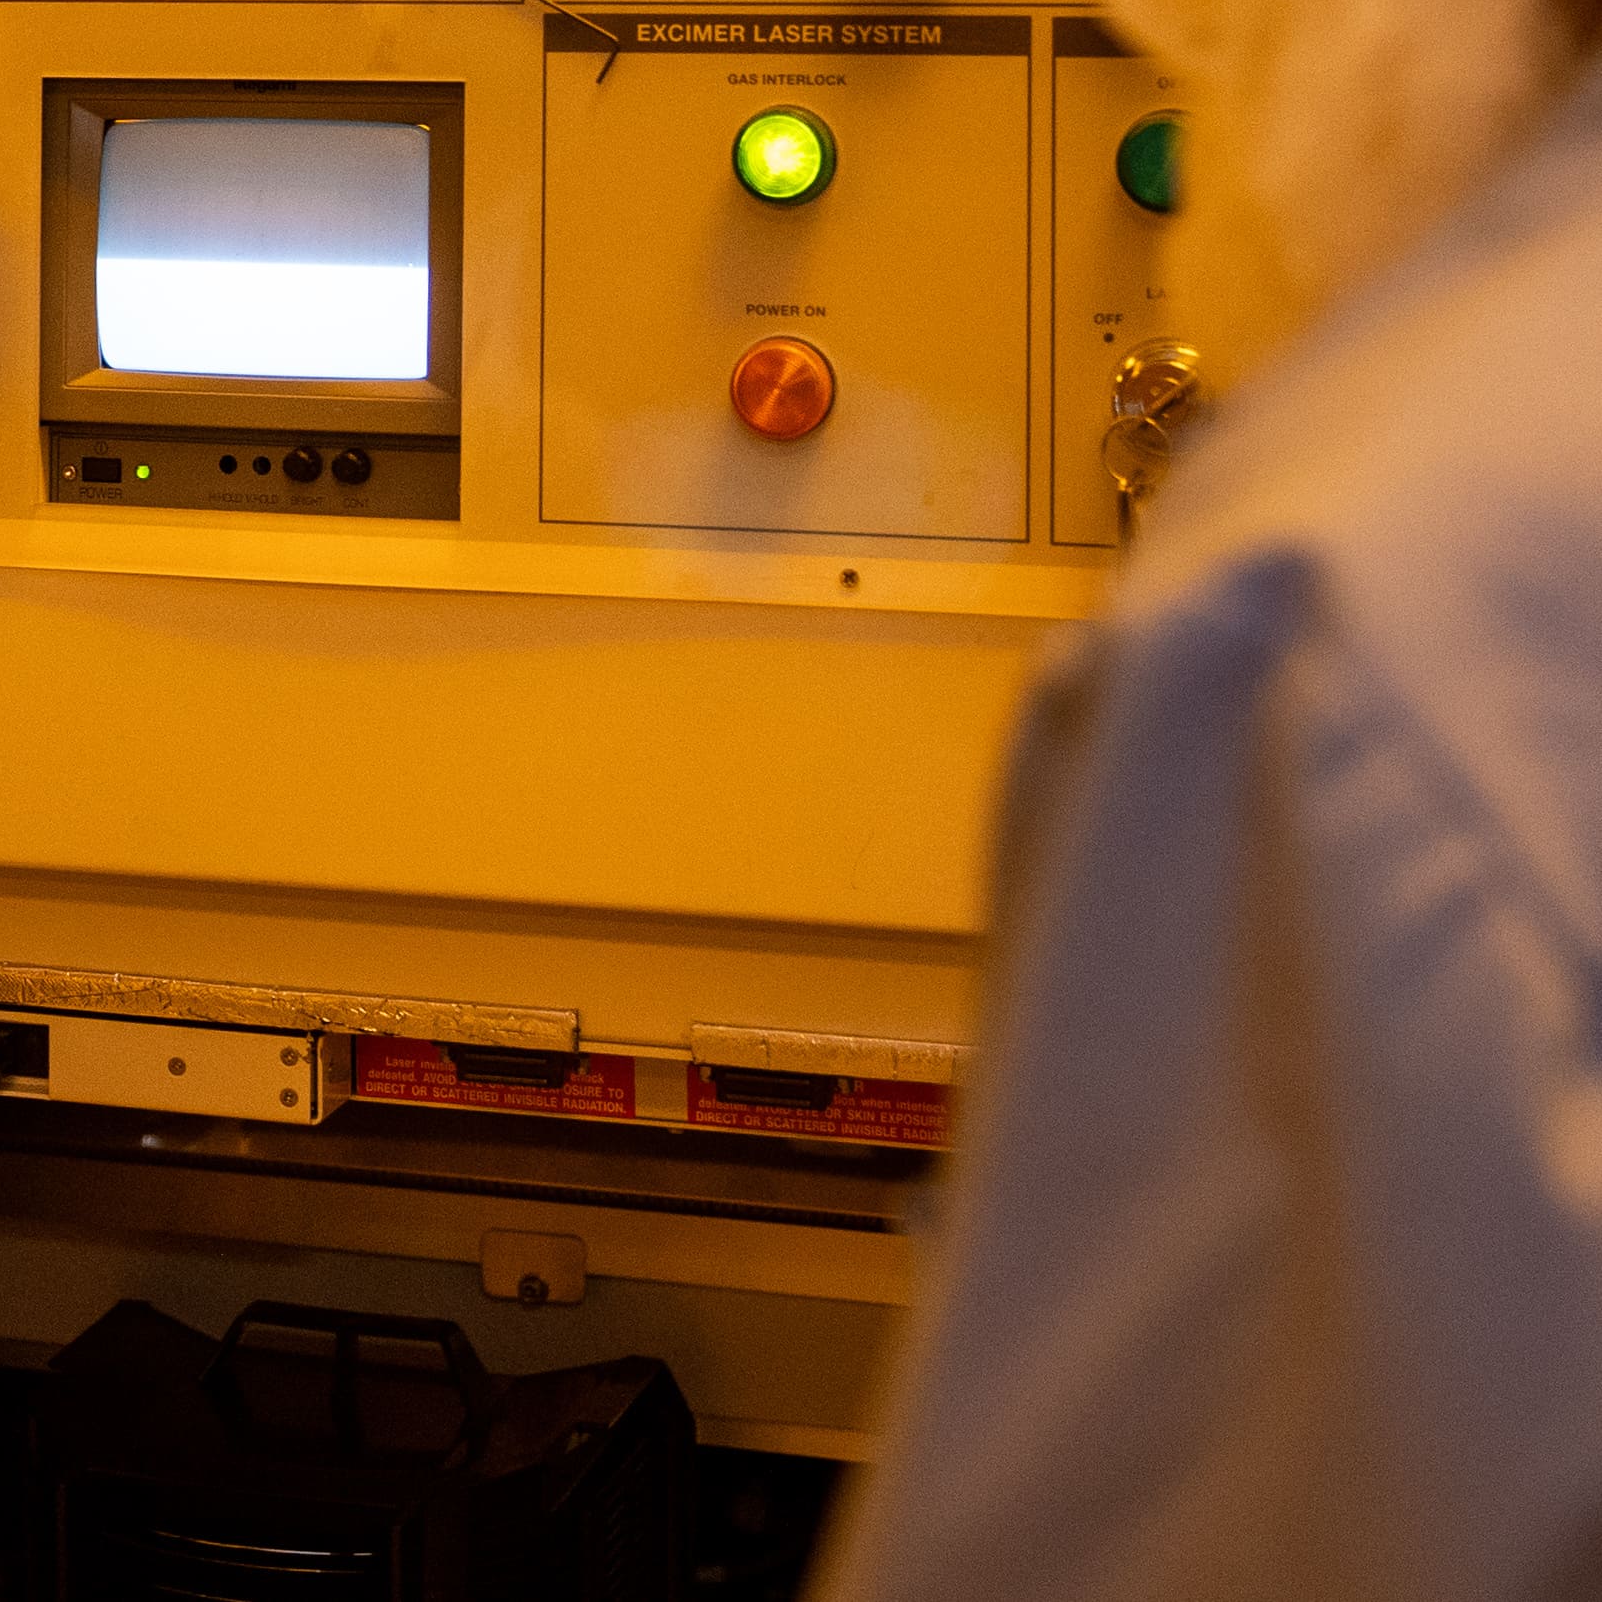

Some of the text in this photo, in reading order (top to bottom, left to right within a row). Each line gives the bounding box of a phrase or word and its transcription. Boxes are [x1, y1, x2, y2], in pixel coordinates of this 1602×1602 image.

[637, 24, 941, 44] EXCIMER LASER SYSTEM
[728, 74, 846, 86] GAS INTERLOCK
[746, 304, 825, 317] POWER ON
[1093, 313, 1123, 324] OFF
[80, 488, 122, 499] POWER
[386, 1056, 415, 1068] Laser
[423, 1072, 456, 1085] AVOID
[366, 1082, 626, 1114] DIRECT OR SCATTERED INVISIBLE RADIATION.
[608, 1089, 624, 1098] TO
[861, 1098, 891, 1109] when
[847, 1110, 874, 1122] SKIN
[696, 1112, 896, 1138] DIRECT OR SCATTERED INVISIBLE
